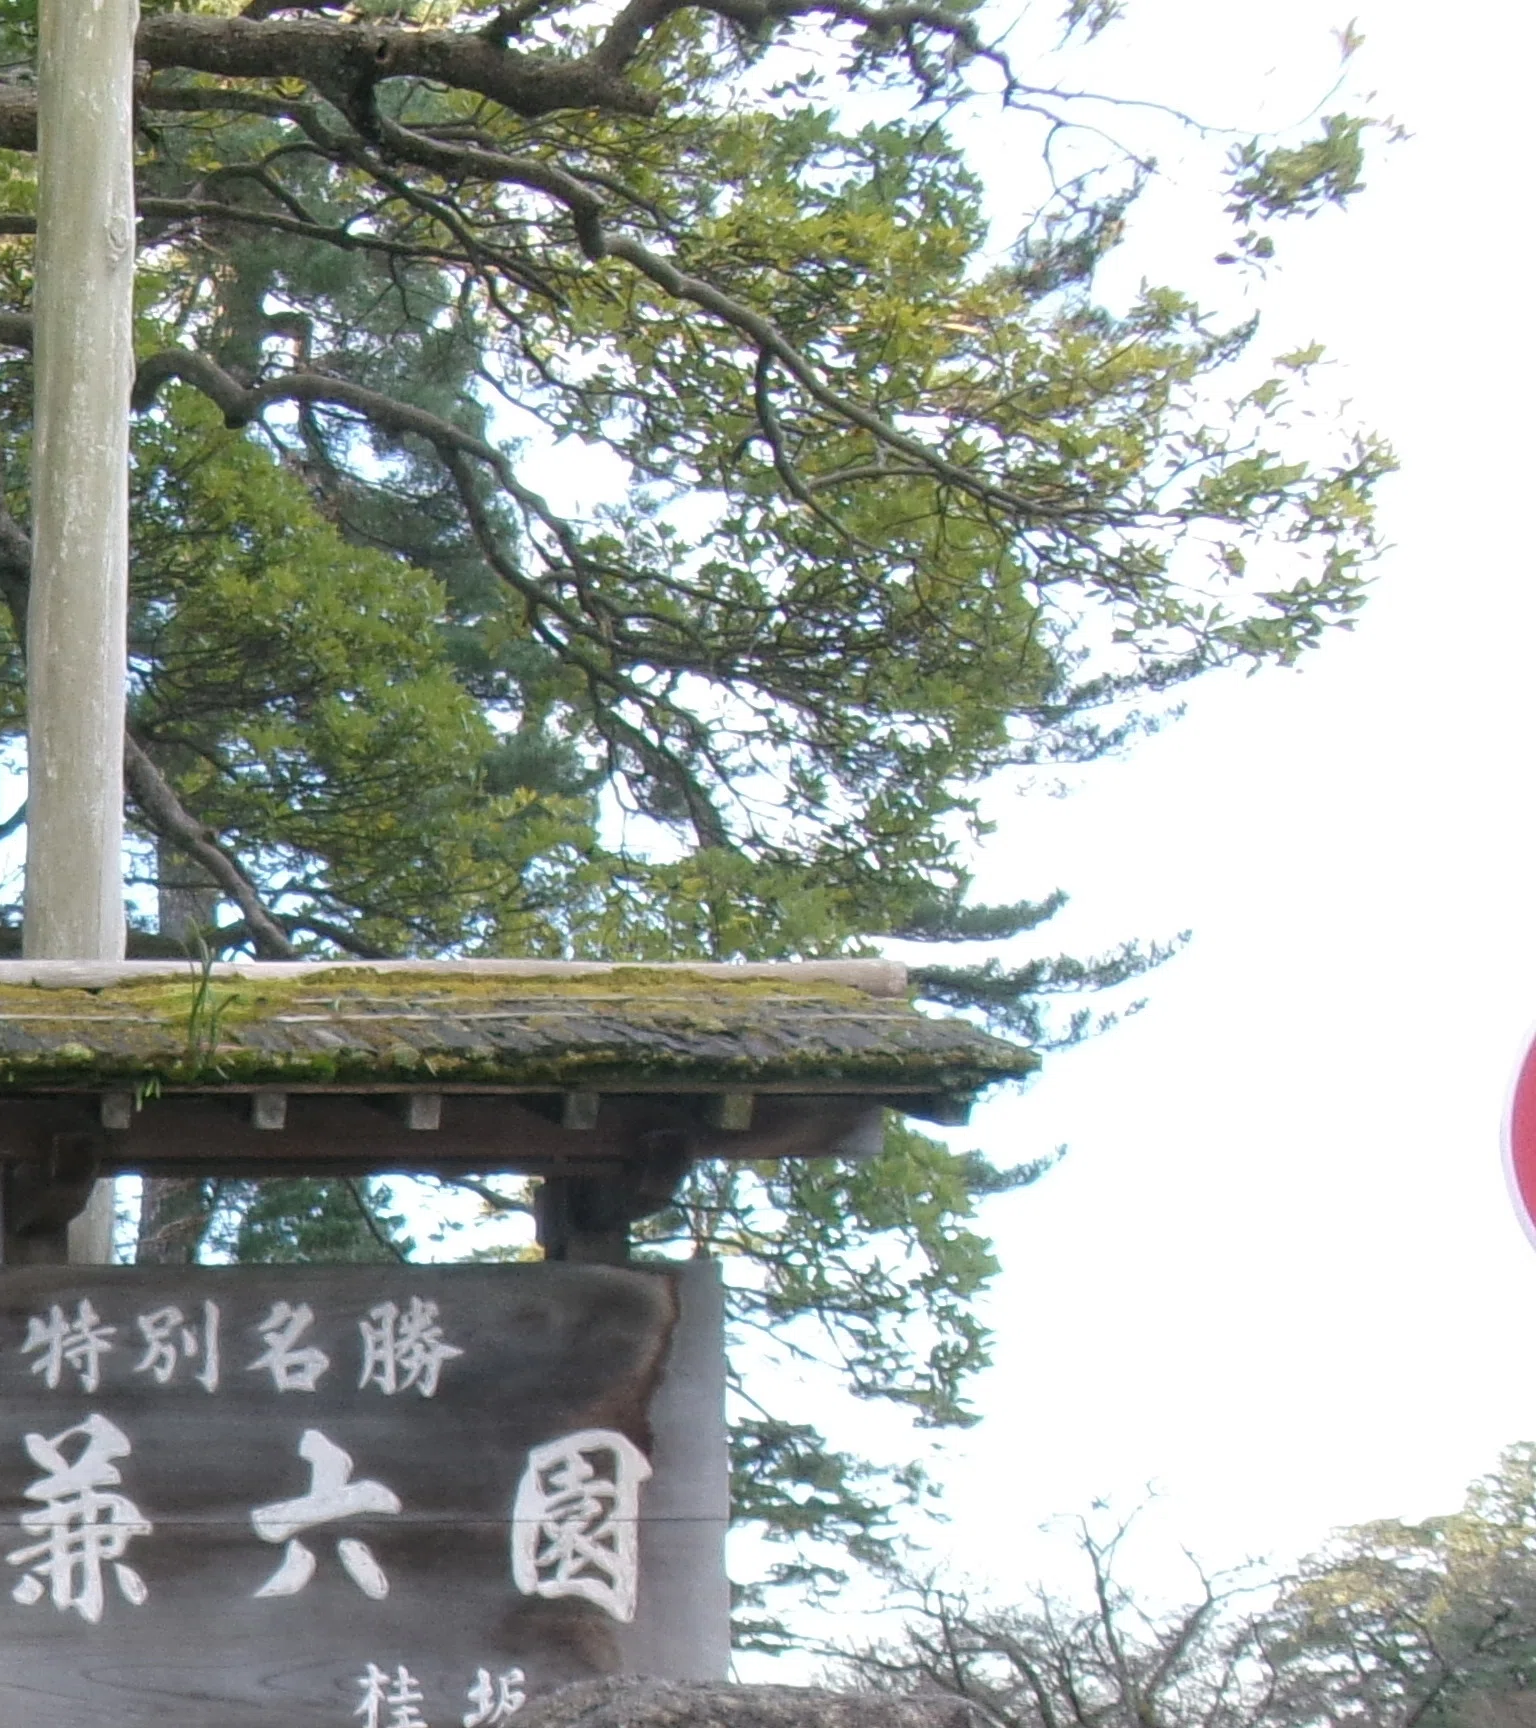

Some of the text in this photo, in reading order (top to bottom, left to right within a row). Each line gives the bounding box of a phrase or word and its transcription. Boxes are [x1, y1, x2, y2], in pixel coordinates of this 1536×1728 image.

[20, 1297, 463, 1397] 特別名勝
[7, 1413, 653, 1623] 兼六園
